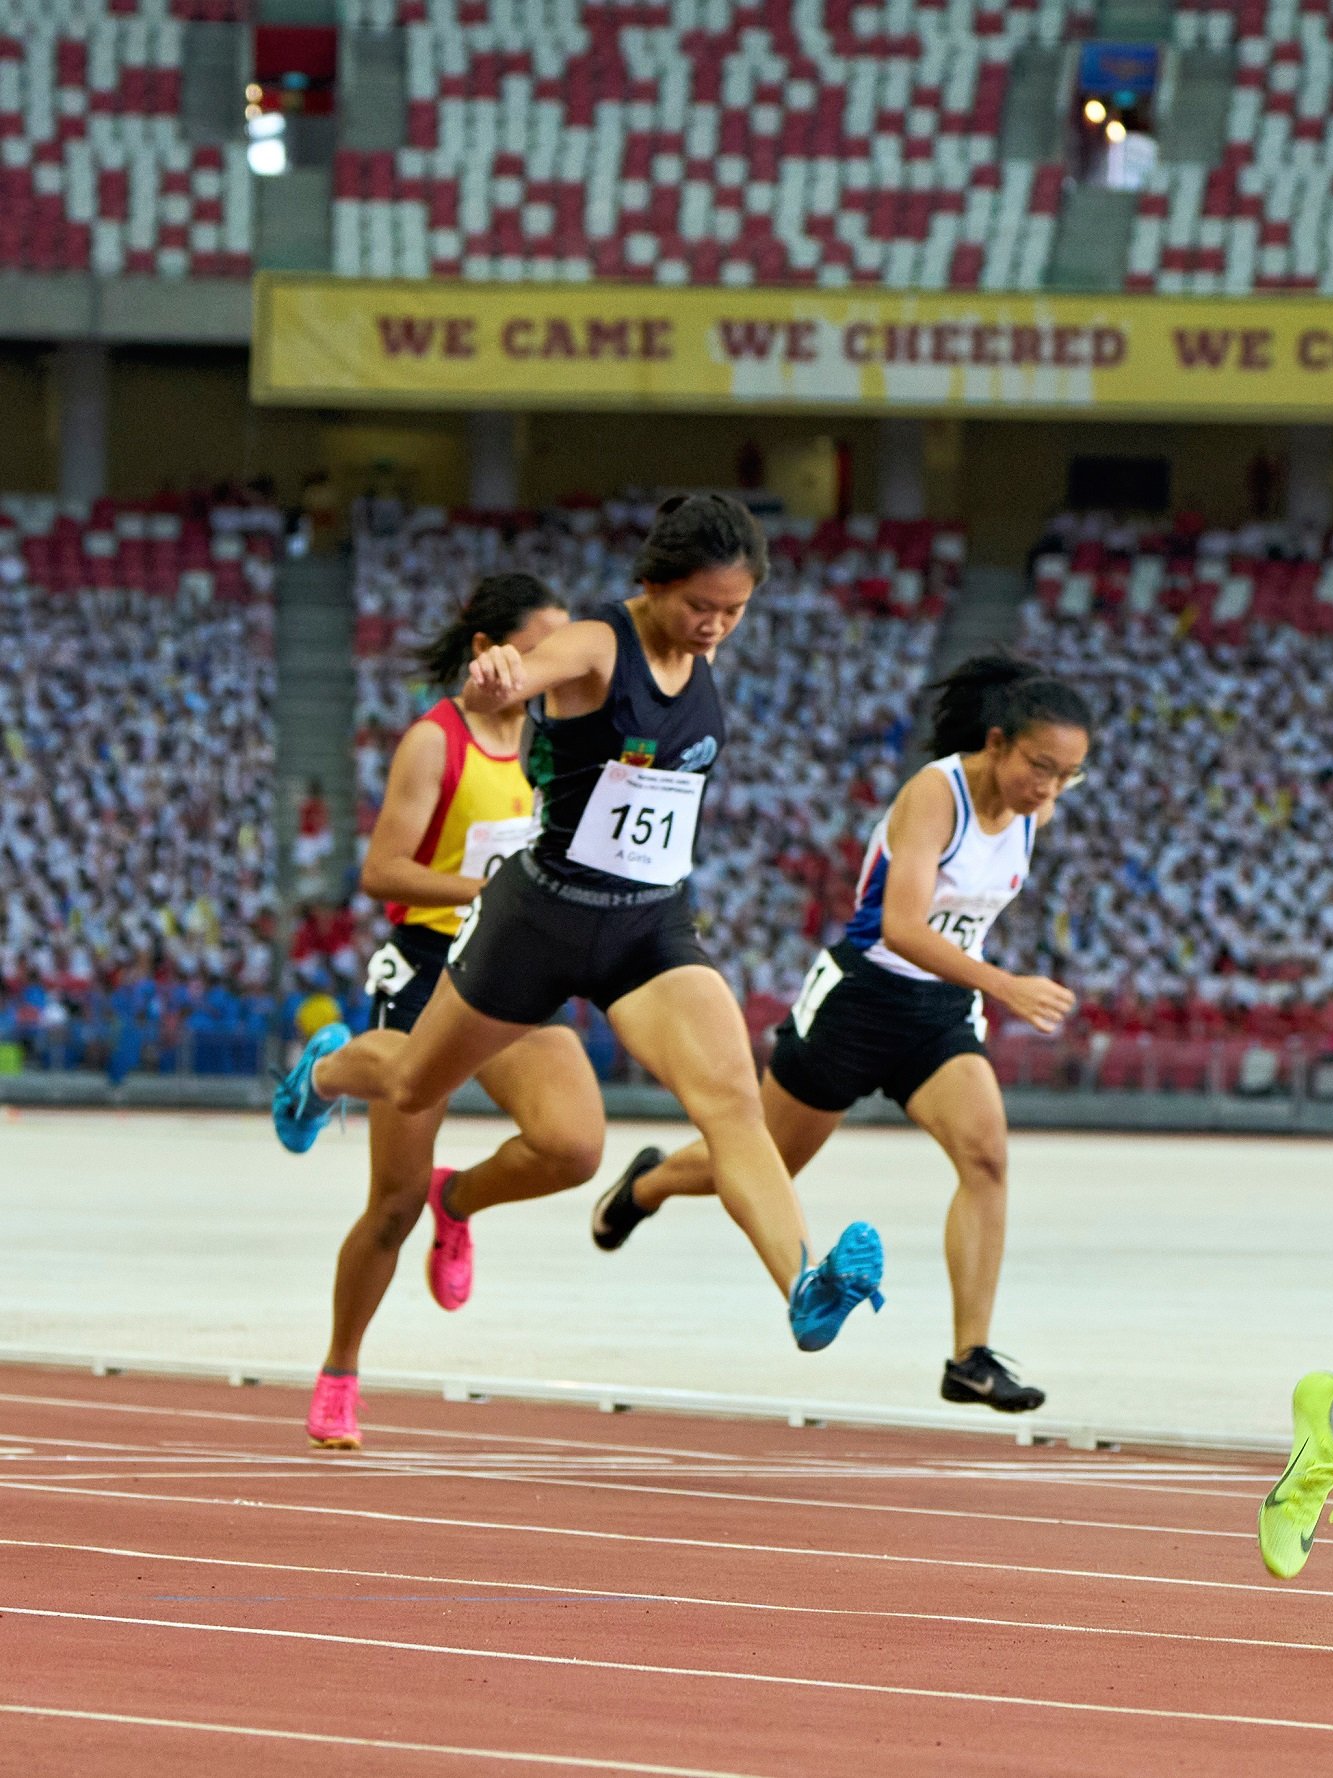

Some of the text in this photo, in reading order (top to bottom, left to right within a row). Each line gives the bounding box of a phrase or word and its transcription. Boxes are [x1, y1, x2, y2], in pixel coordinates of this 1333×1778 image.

[375, 314, 475, 362] WE
[501, 315, 672, 363] CAME
[718, 319, 816, 364] WE
[842, 321, 1128, 369] CHEERED
[1173, 327, 1272, 371] WE
[610, 804, 674, 849] 151
